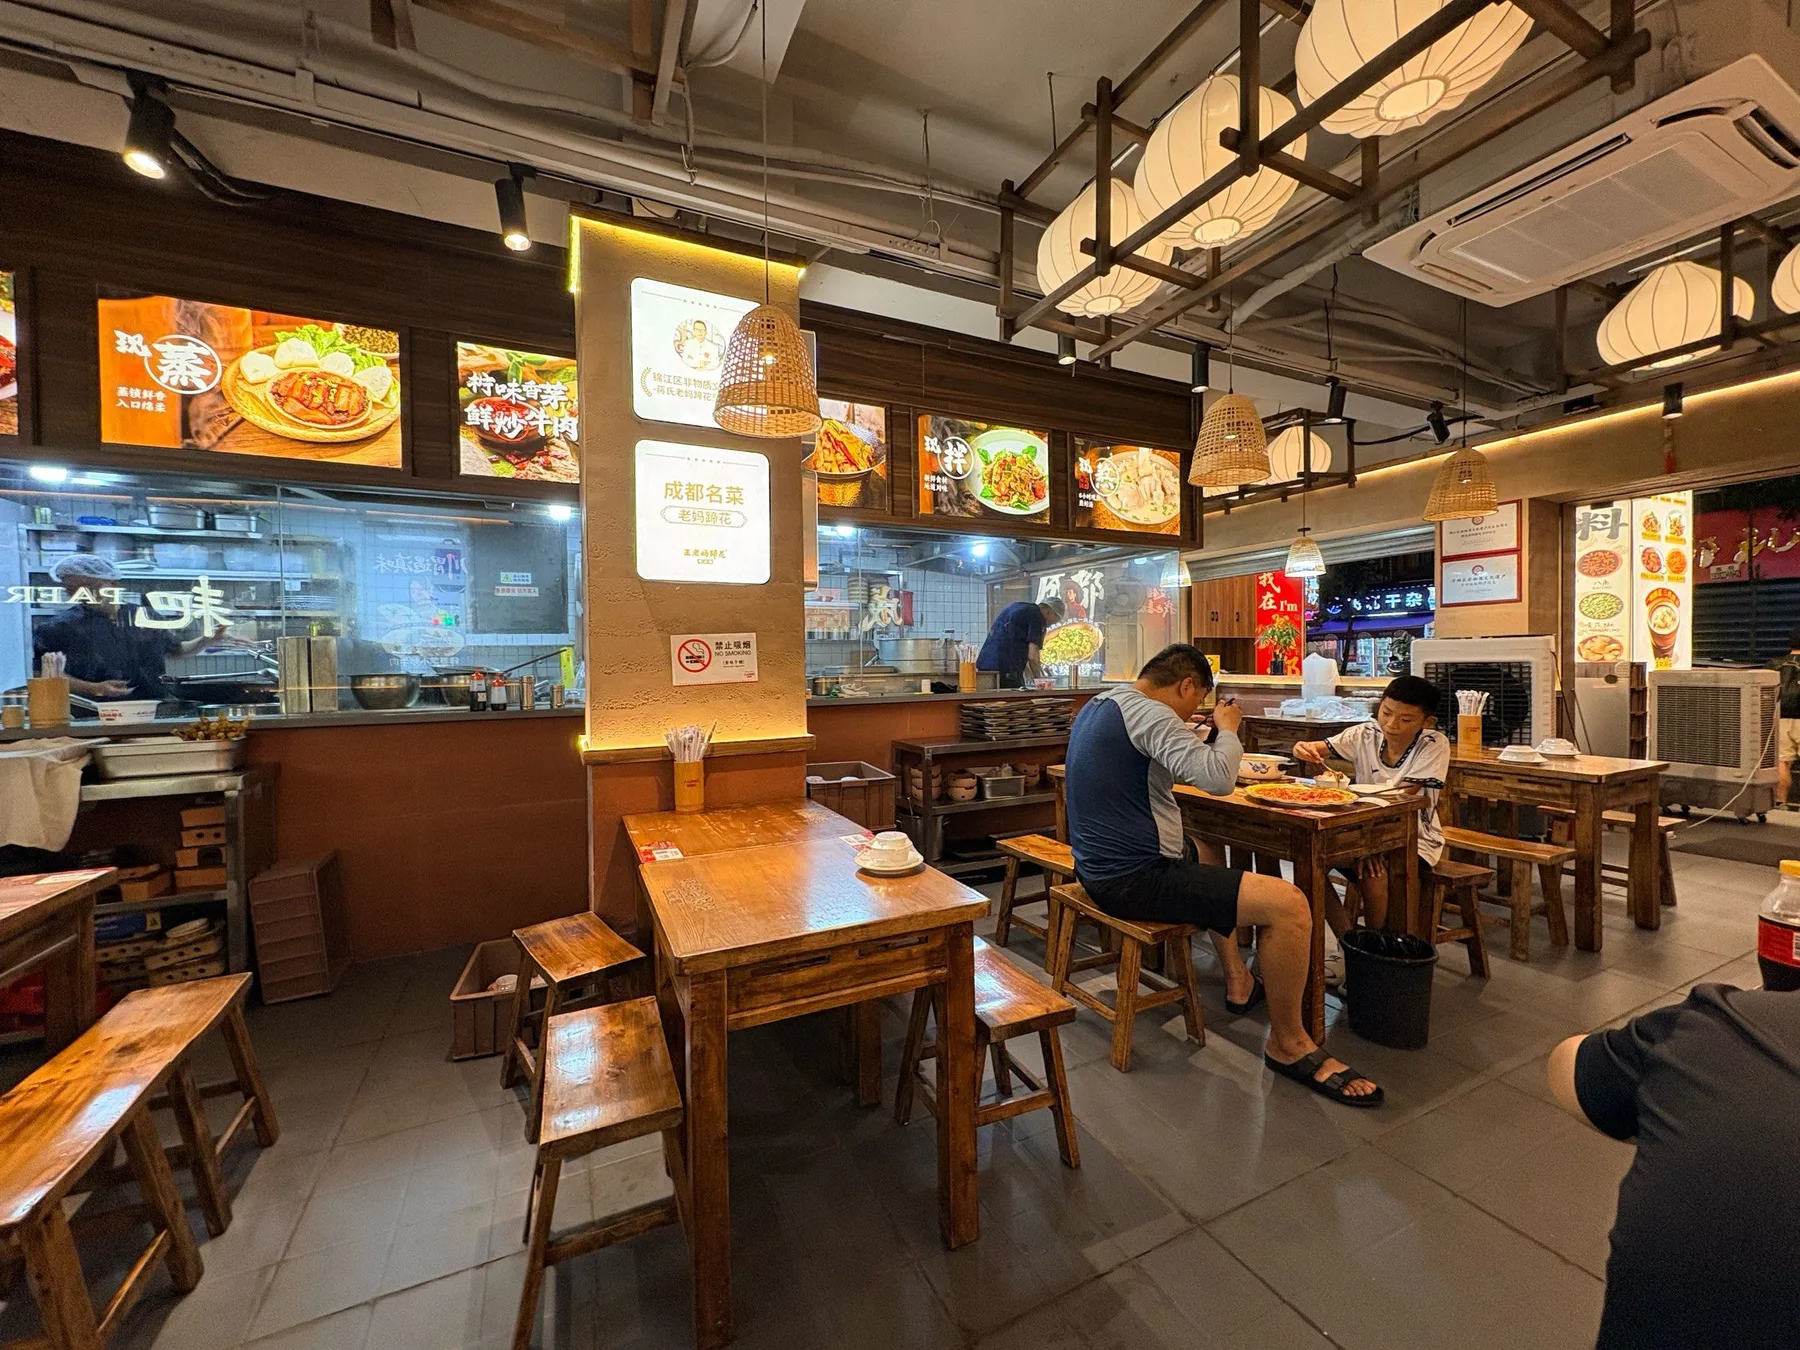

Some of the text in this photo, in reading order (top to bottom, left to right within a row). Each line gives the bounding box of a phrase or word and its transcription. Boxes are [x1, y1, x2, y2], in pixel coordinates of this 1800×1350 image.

[467, 371, 569, 410] 柠味香茅
[116, 399, 166, 413] 入口绵柔
[464, 403, 579, 441] 鲜炒牛肉
[924, 436, 967, 475] 现拌
[664, 481, 744, 505] 成都名菜
[678, 509, 732, 525] 老妈蹄花
[1279, 600, 1298, 612] I'm
[715, 641, 751, 650] 禁止吸烟
